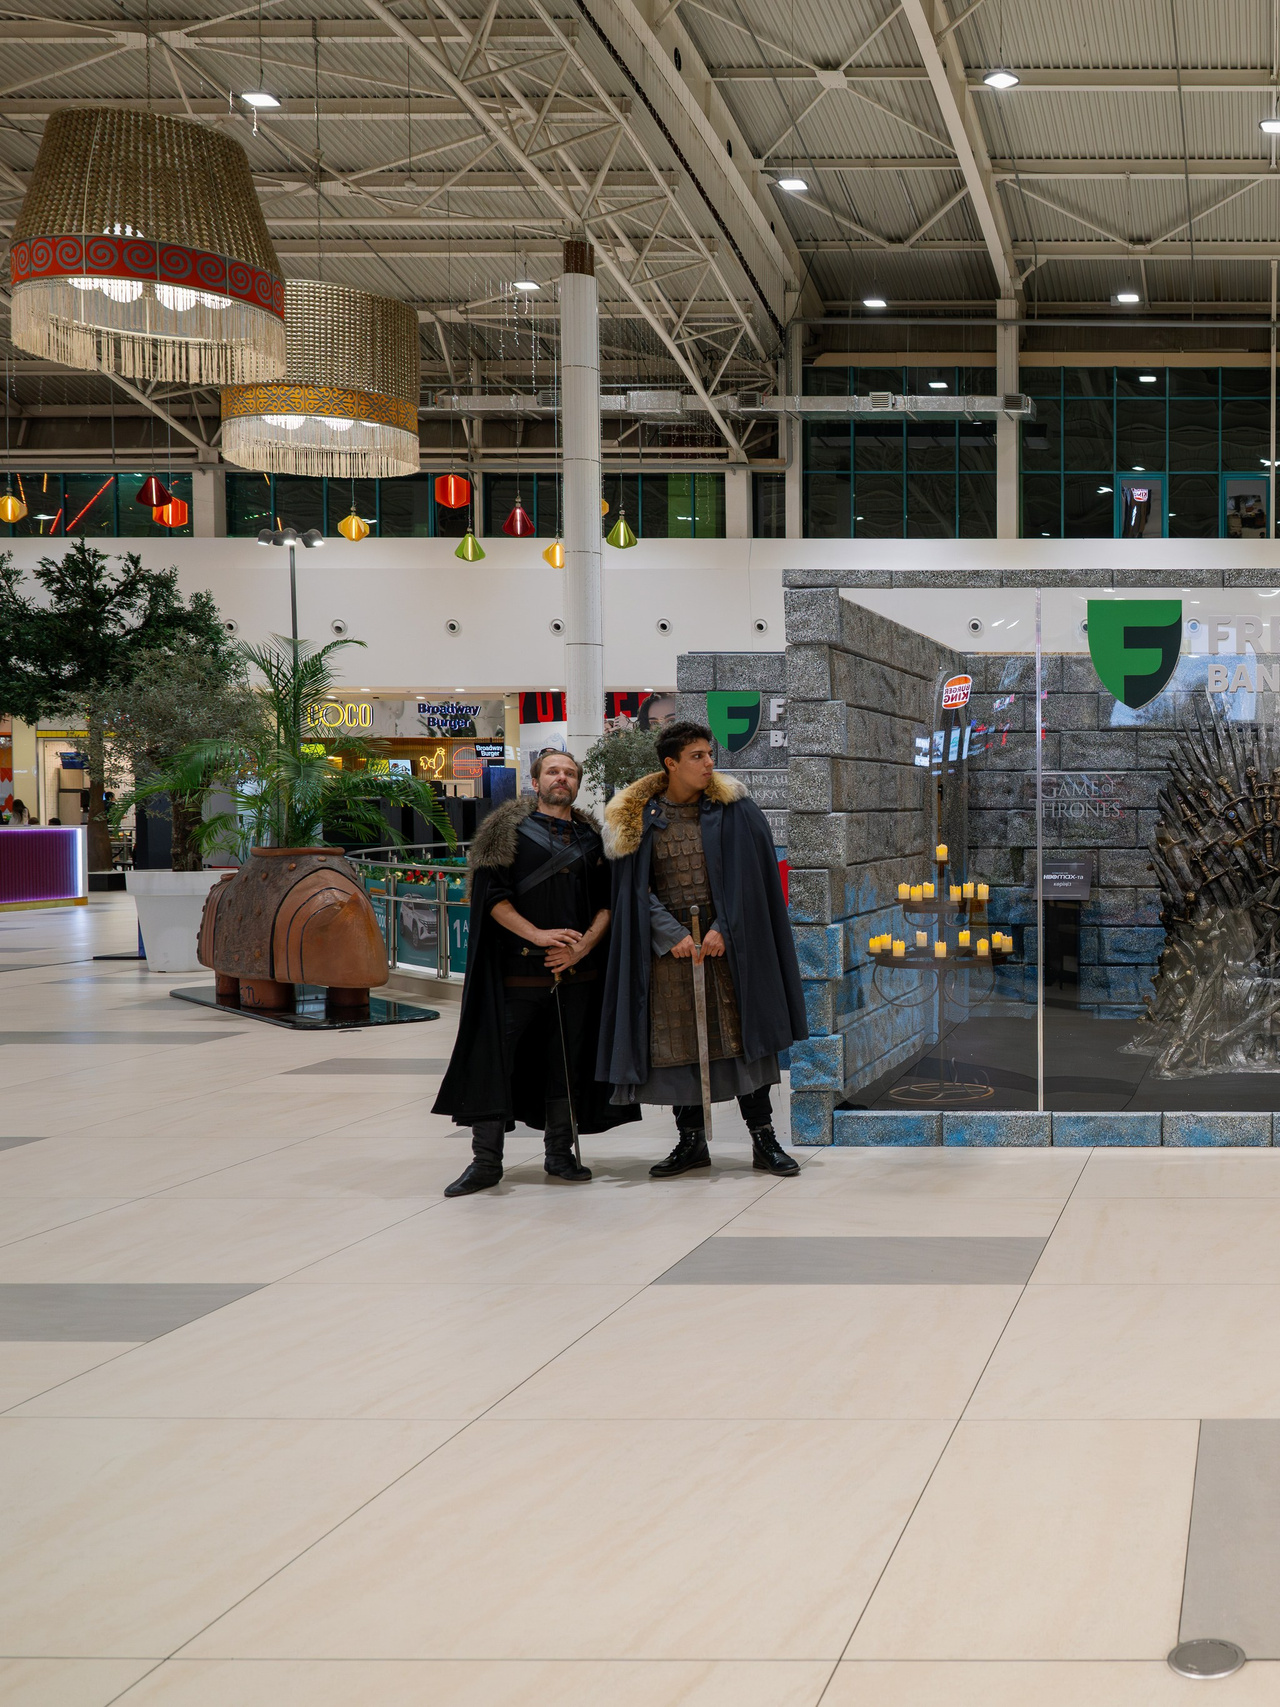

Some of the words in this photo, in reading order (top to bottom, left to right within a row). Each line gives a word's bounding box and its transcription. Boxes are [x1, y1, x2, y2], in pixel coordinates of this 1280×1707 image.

[308, 703, 373, 728] COCO
[418, 703, 481, 717] Broadway
[428, 717, 472, 730] Burger
[476, 744, 503, 752] Broadway
[1041, 777, 1100, 799] GAME
